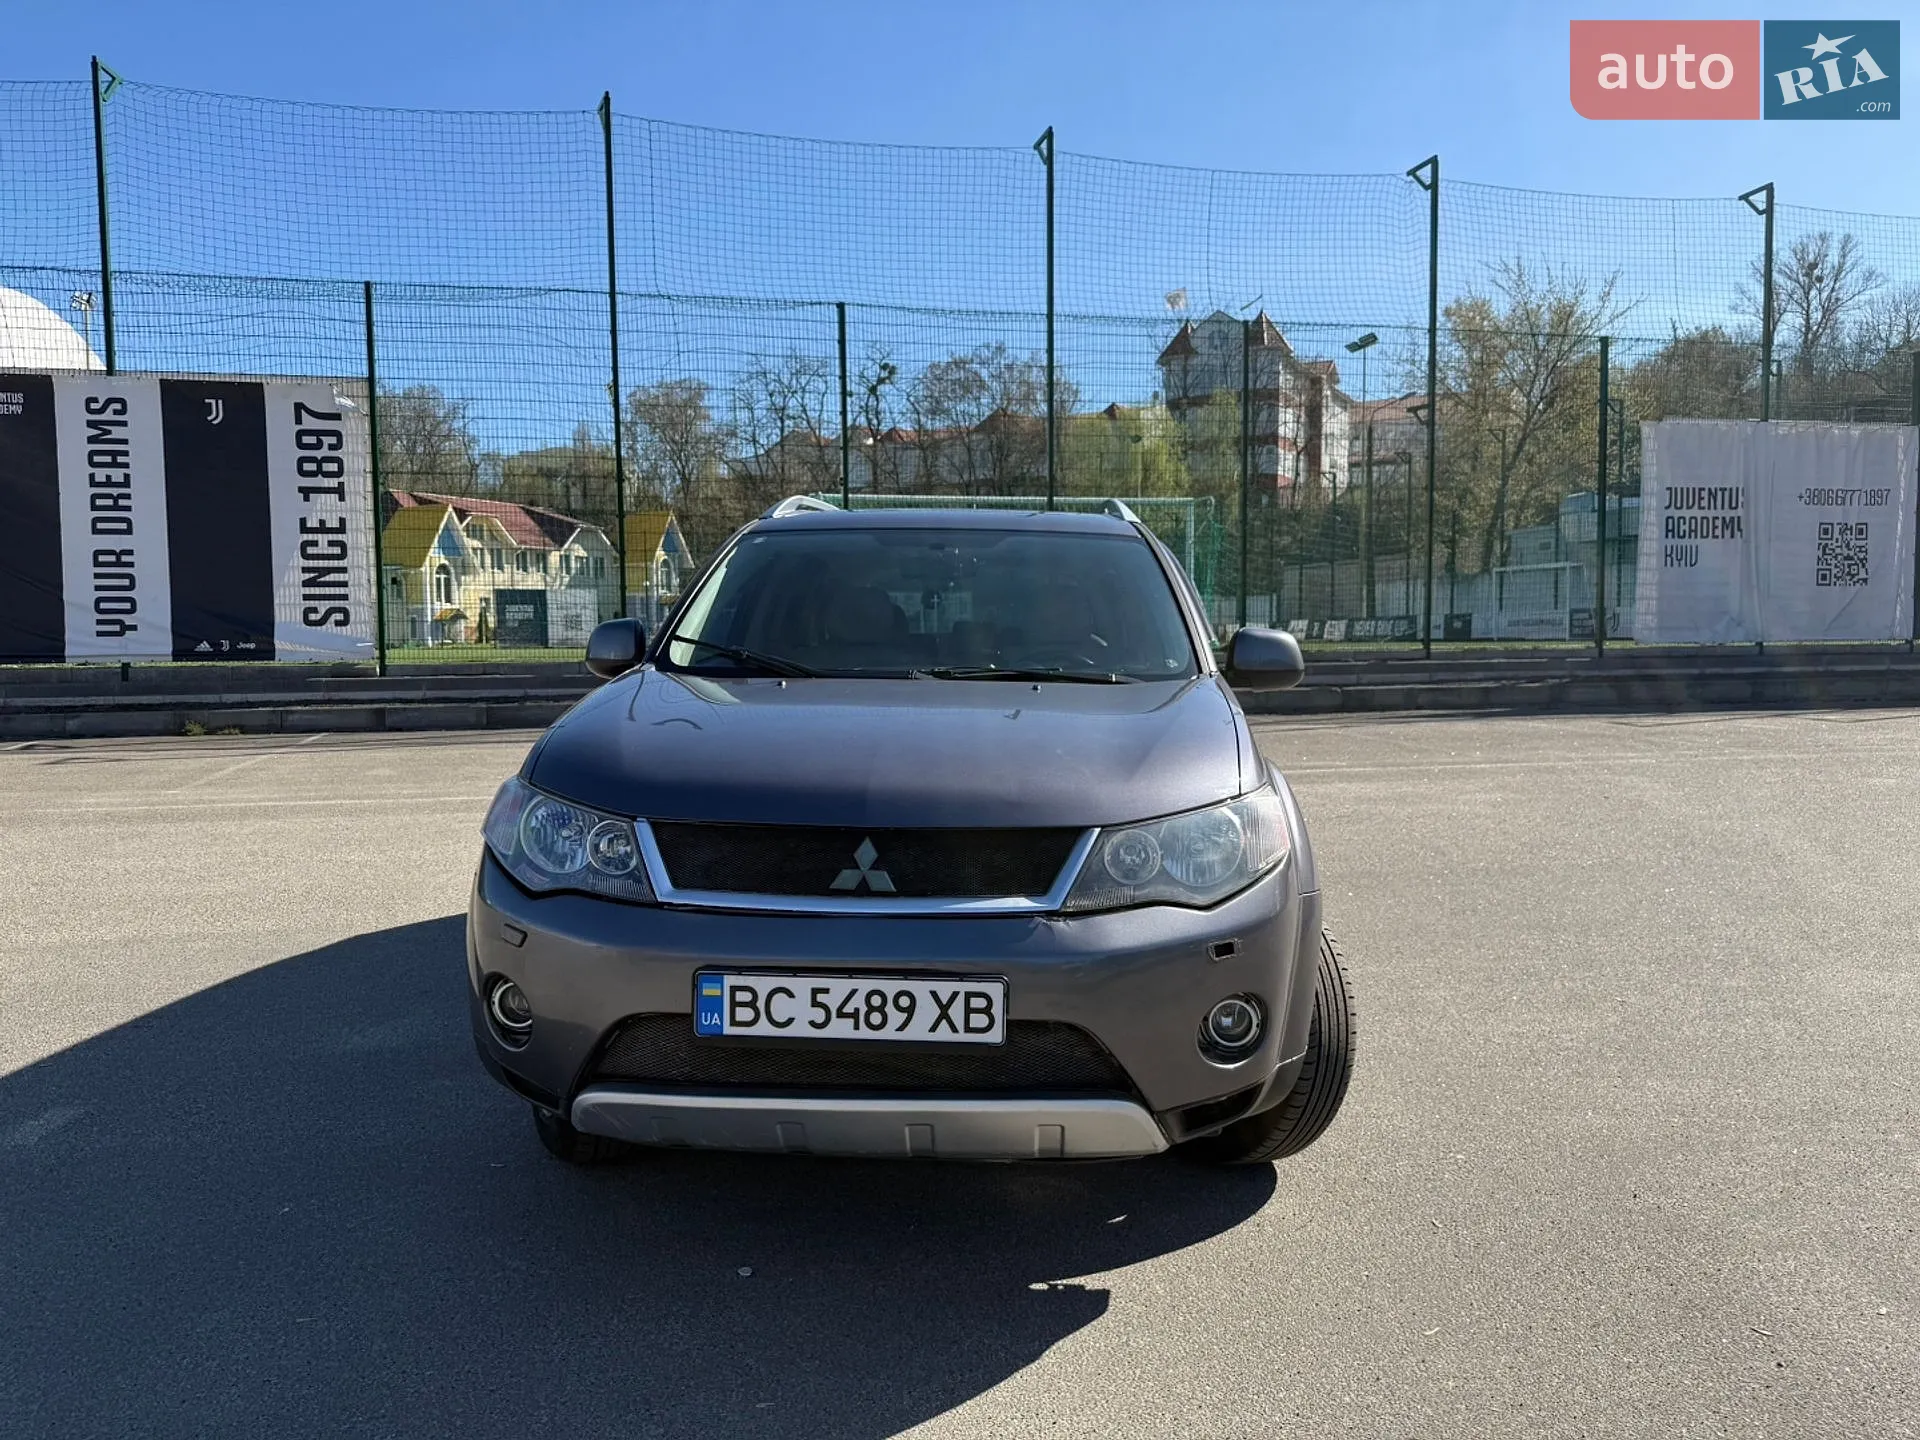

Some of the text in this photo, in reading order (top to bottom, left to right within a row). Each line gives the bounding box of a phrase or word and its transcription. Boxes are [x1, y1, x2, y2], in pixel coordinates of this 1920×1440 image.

[84, 396, 138, 638] YOUR DREAMS
[293, 401, 351, 628] SINCE 1897
[1664, 543, 1699, 568] KYIV
[701, 1012, 721, 1026] UA
[729, 985, 996, 1034] BC 5489 XB
